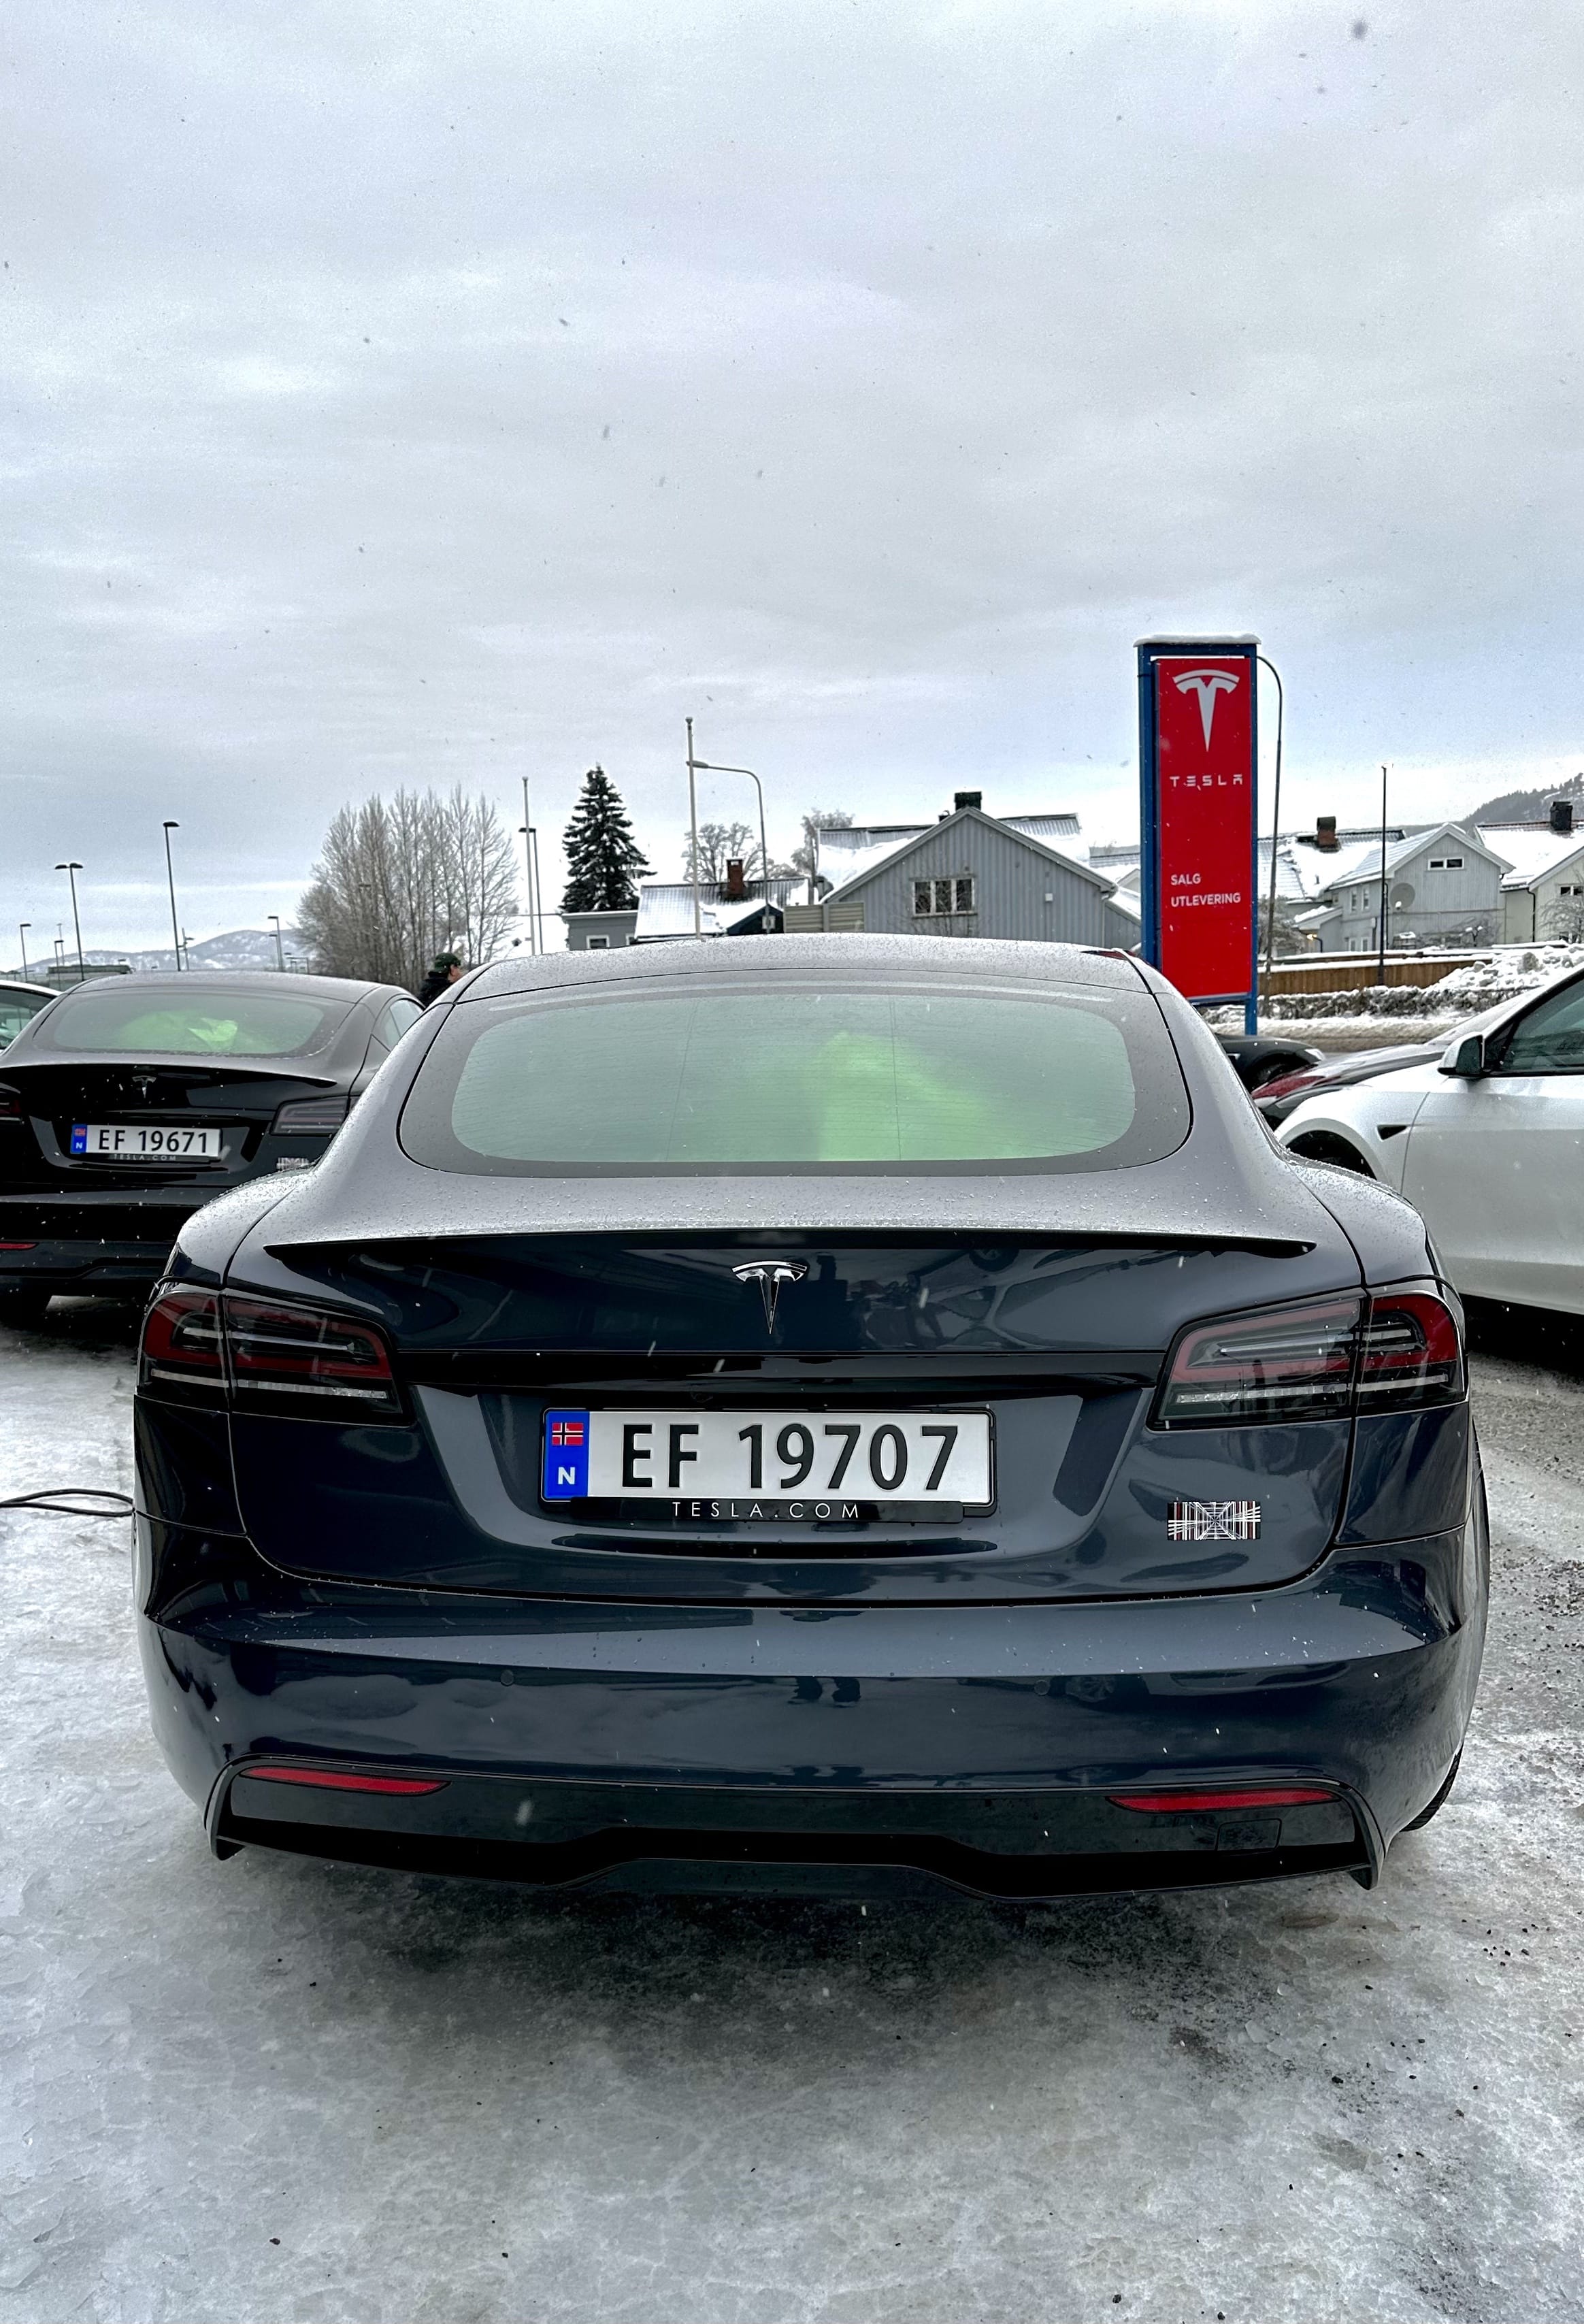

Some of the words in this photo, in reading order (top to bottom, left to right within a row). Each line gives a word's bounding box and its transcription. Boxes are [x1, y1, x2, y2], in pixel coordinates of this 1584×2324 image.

[1170, 774, 1242, 787] TESLA
[1170, 873, 1201, 885] SALG
[1170, 892, 1241, 907] UTLEVERING
[99, 1129, 126, 1150] EF
[138, 1130, 207, 1153] 19671
[622, 1424, 699, 1488] EF
[738, 1424, 959, 1490] 19707
[558, 1467, 576, 1486] N
[672, 1501, 859, 1519] TESLA.COM
